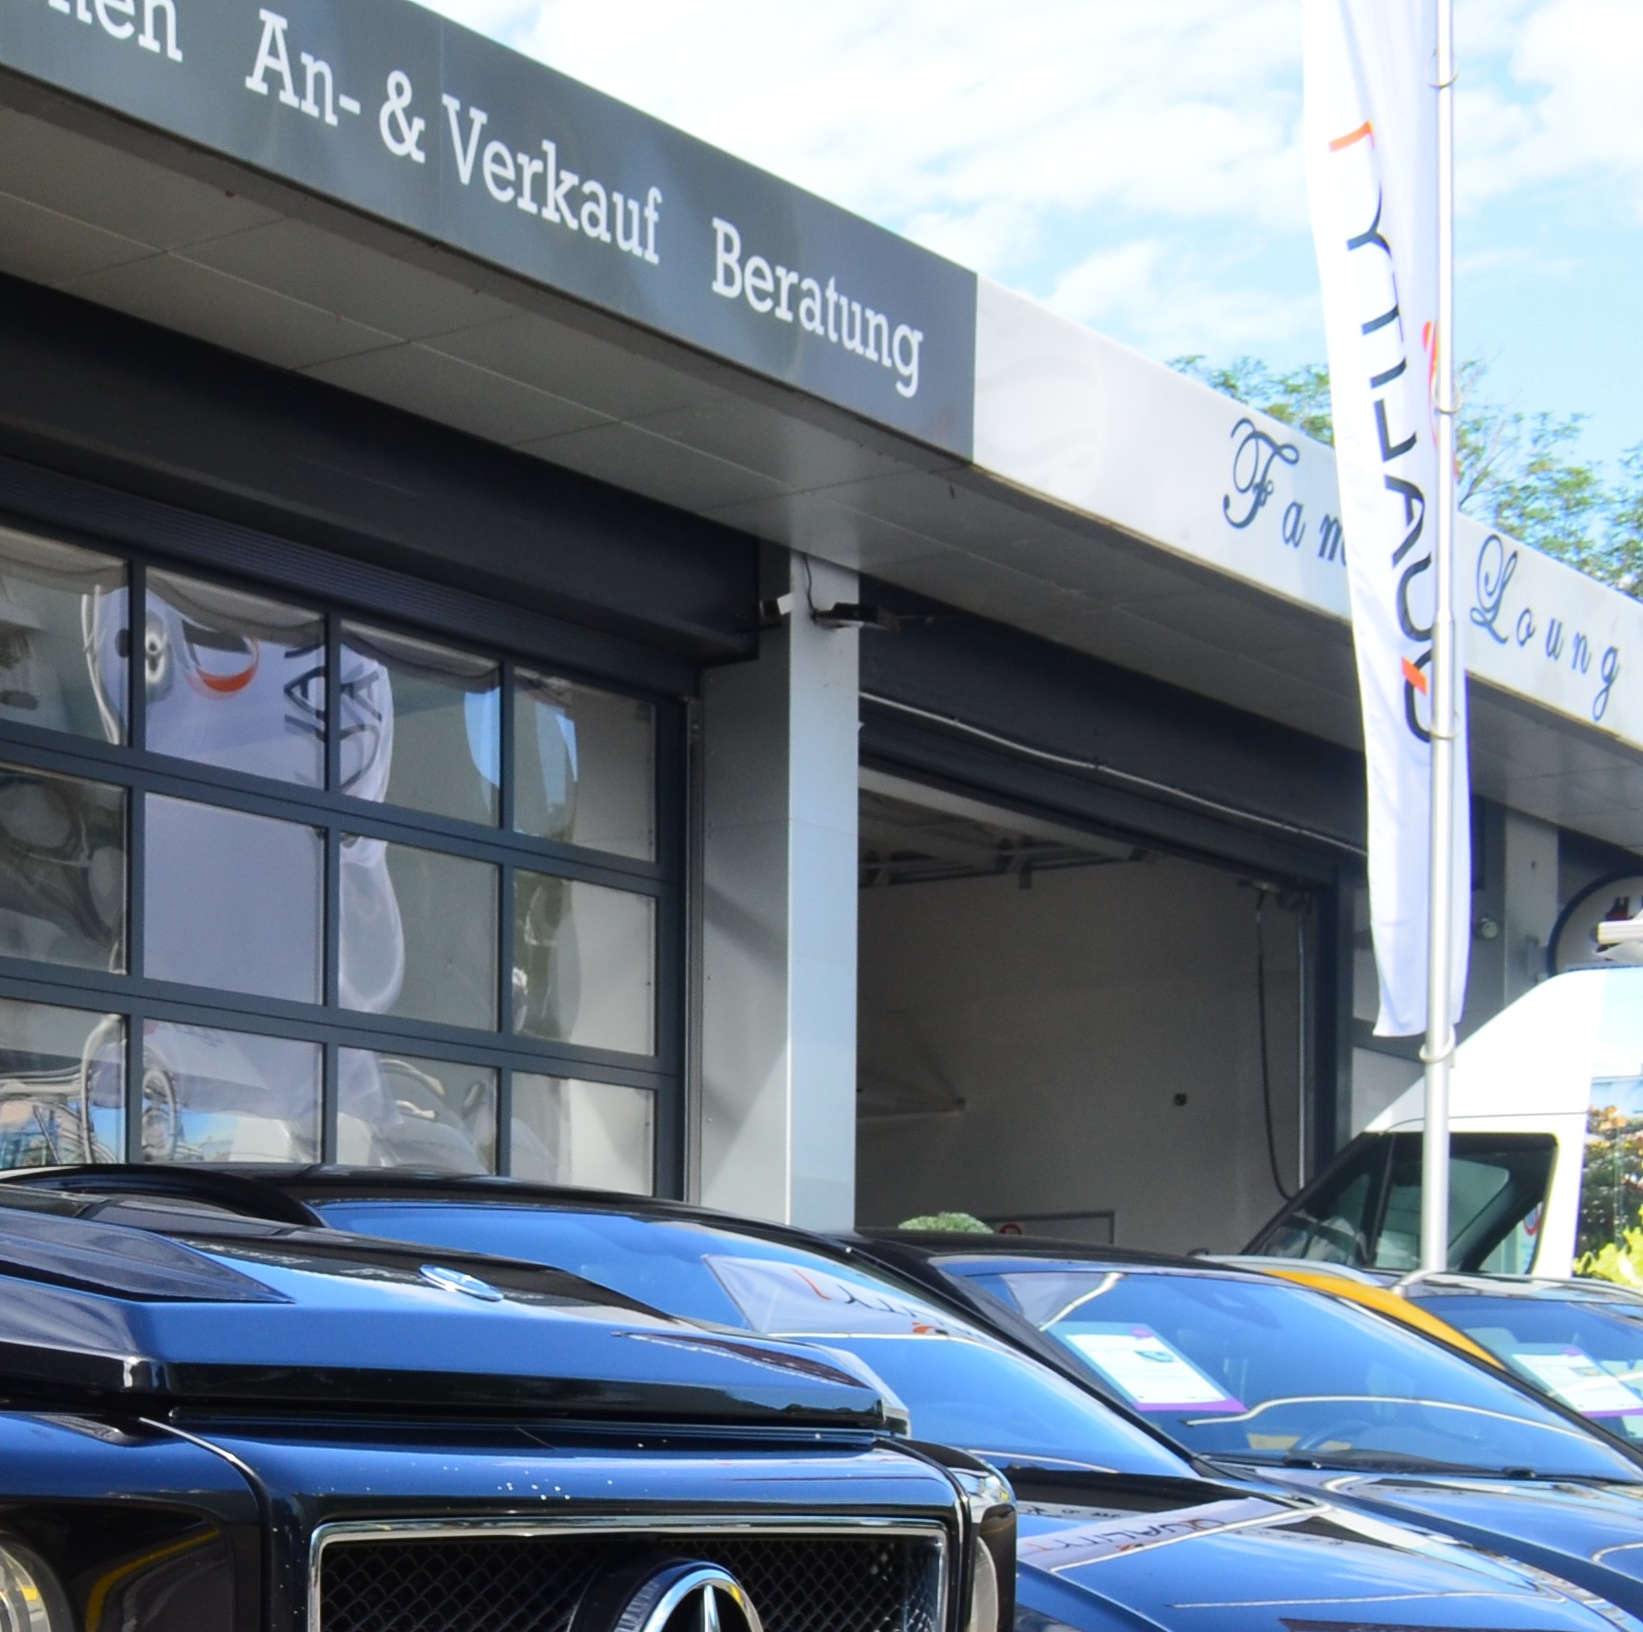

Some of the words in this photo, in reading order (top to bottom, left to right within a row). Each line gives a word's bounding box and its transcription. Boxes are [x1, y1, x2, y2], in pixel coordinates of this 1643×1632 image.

[245, 8, 361, 127] An-
[379, 70, 425, 164] &
[442, 94, 663, 265] Verkauf
[712, 216, 924, 398] Beratung
